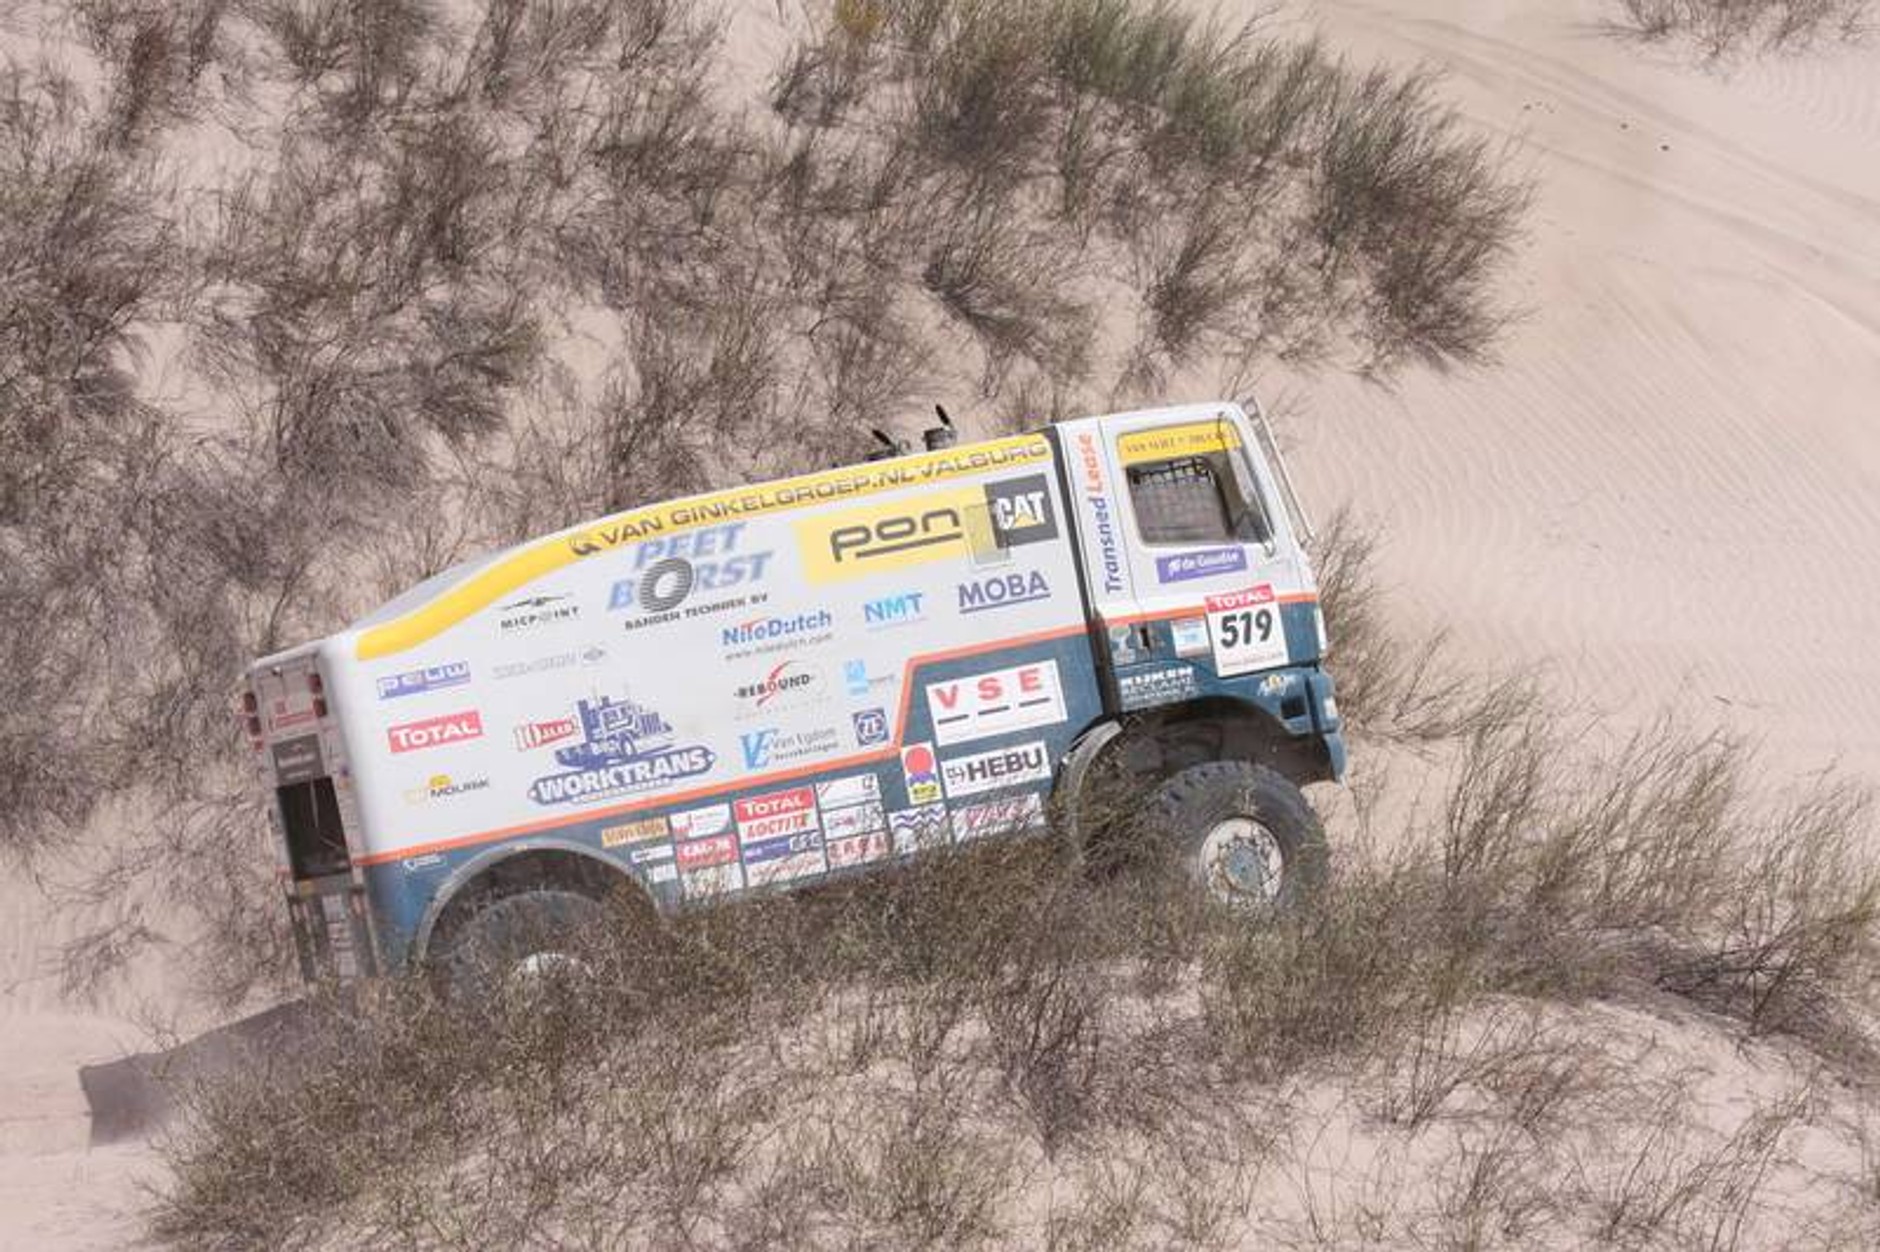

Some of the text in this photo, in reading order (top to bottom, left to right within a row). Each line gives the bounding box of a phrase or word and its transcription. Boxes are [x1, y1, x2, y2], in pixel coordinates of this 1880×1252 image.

[601, 515, 663, 544] VAN
[921, 441, 1047, 478] VALBURG
[995, 491, 1046, 530] CAT
[1079, 433, 1122, 594] Transned Lease
[634, 523, 747, 568] PEET
[607, 551, 773, 612] BORST
[959, 570, 1049, 608] MOBA
[1214, 590, 1271, 609] TOTAL
[864, 593, 923, 622] NMT
[1220, 609, 1273, 648] 519
[391, 721, 479, 748] TOTAL
[537, 750, 707, 802] WORKTRANS
[966, 748, 1044, 782] HEBU
[744, 795, 806, 817] TOTAL
